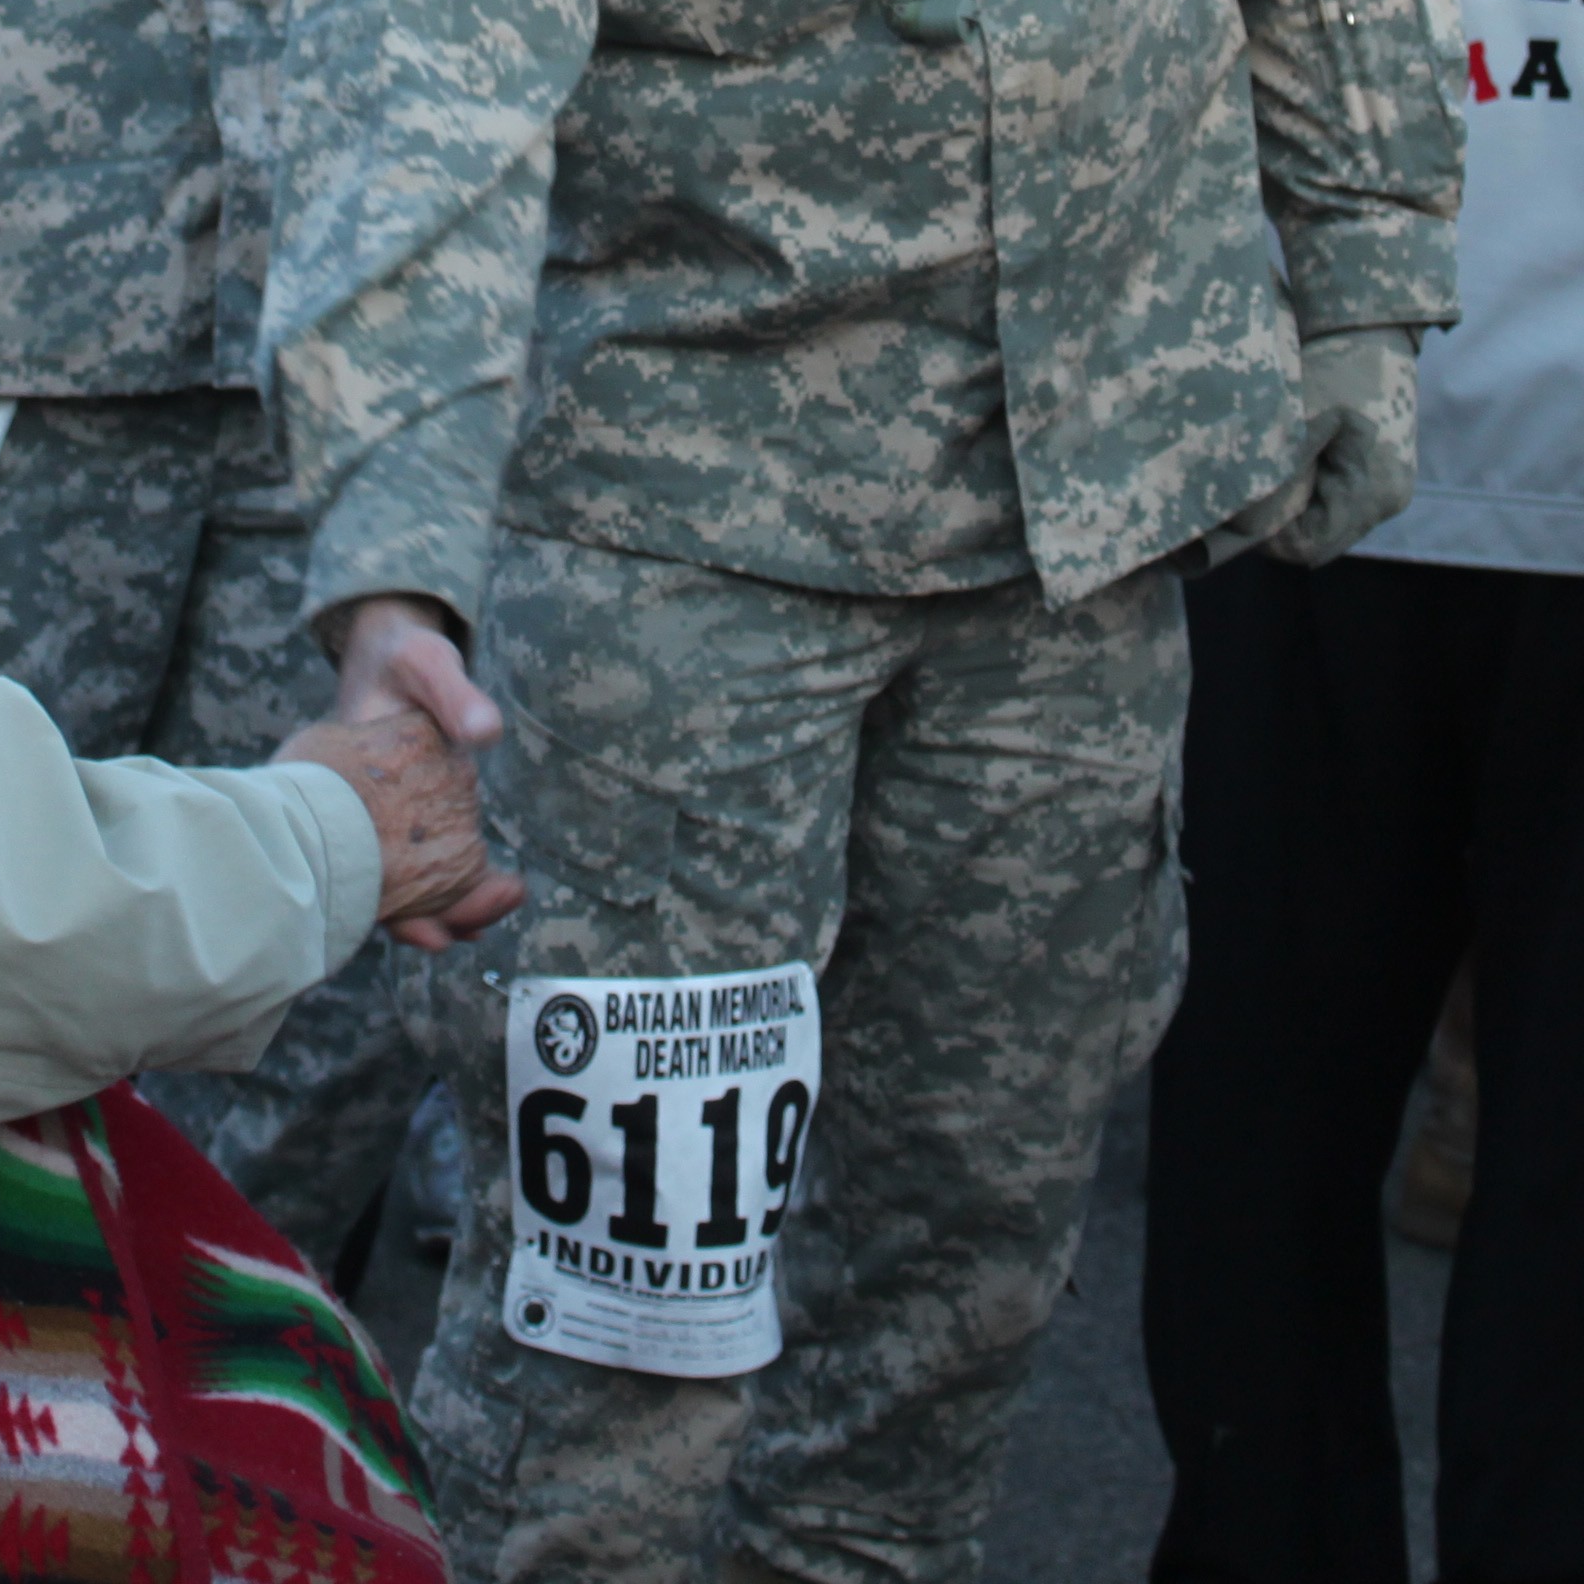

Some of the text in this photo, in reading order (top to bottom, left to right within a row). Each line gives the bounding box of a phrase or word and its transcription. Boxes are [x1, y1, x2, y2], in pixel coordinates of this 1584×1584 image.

[604, 990, 702, 1035] BATAAN
[634, 1026, 787, 1081] DEATH MARCH
[518, 1079, 810, 1250] 6119
